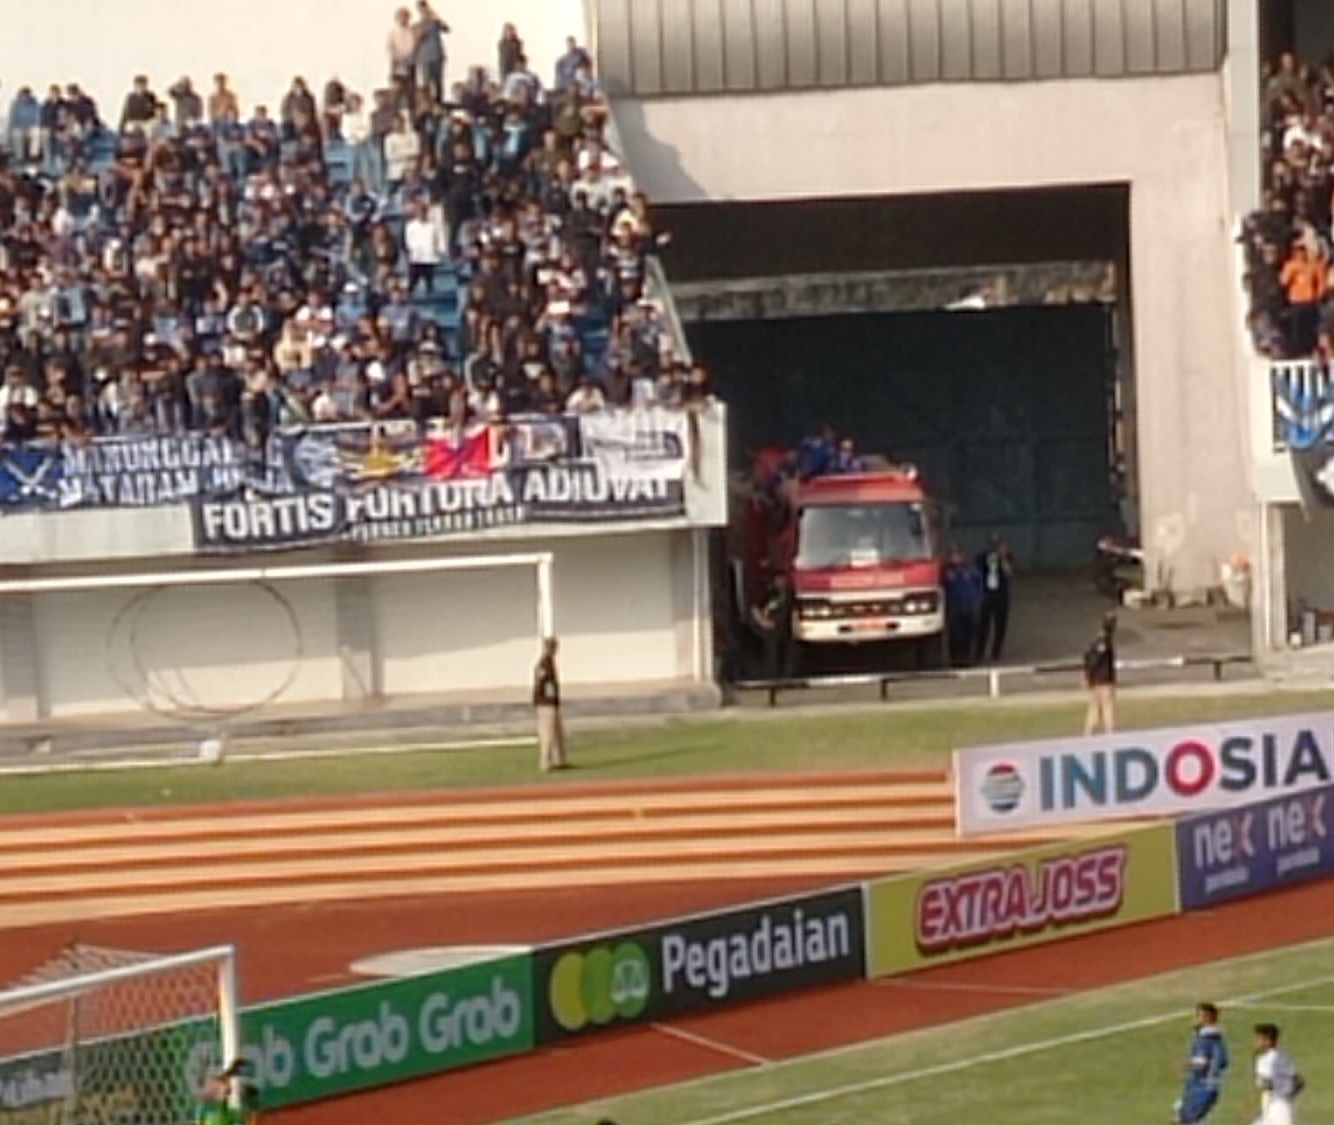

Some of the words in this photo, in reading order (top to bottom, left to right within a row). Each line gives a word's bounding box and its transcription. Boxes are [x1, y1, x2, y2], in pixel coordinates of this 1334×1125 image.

[201, 493, 335, 540] FORTIS
[918, 866, 1031, 946] EXTRA
[1030, 846, 1126, 919] JOSS
[661, 909, 850, 998] Pegadaian
[304, 1000, 410, 1079] Grab
[418, 975, 522, 1053] Grab
